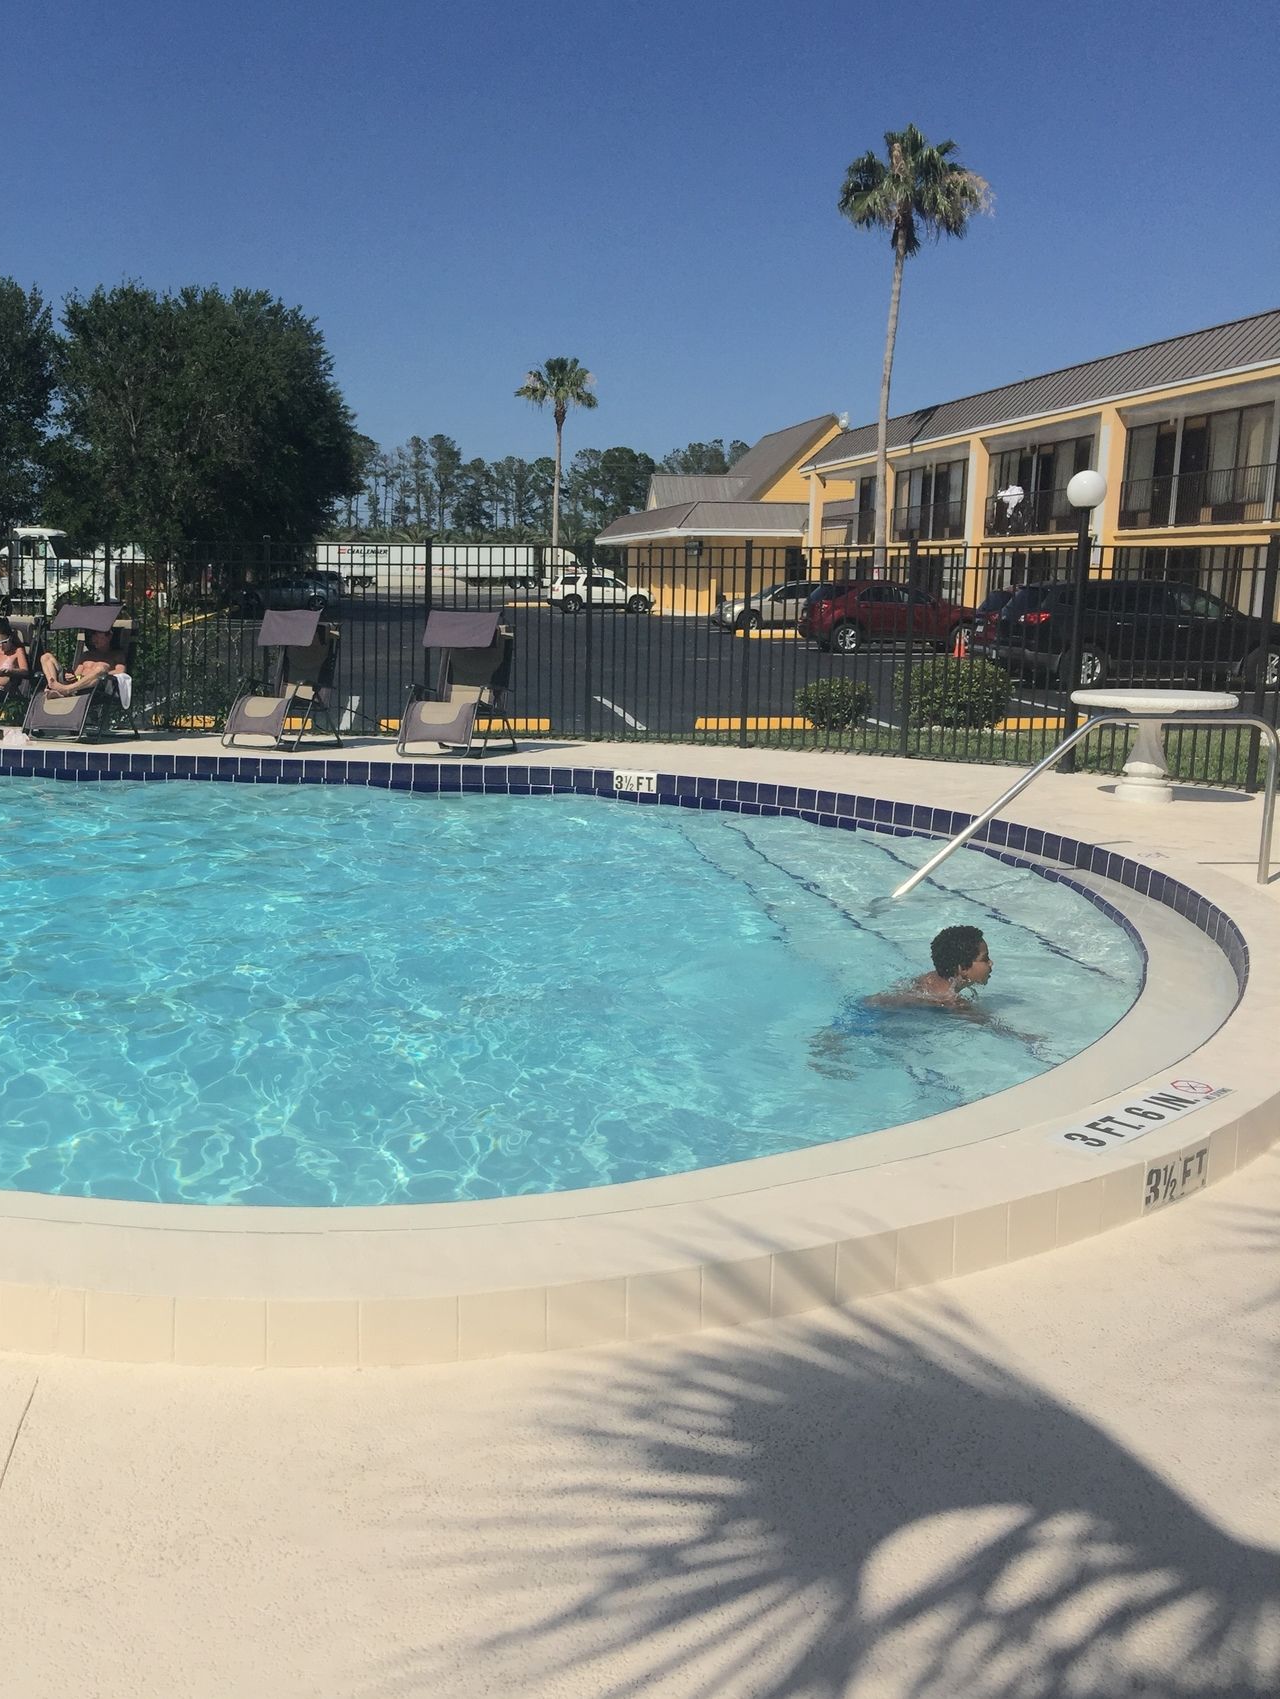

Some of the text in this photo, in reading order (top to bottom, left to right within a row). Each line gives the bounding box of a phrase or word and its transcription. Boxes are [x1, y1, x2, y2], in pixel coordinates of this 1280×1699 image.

[1142, 1092, 1201, 1111] IN.
[1124, 1107, 1166, 1121] 6
[1084, 1115, 1146, 1138] FT.
[1064, 1132, 1107, 1147] 3
